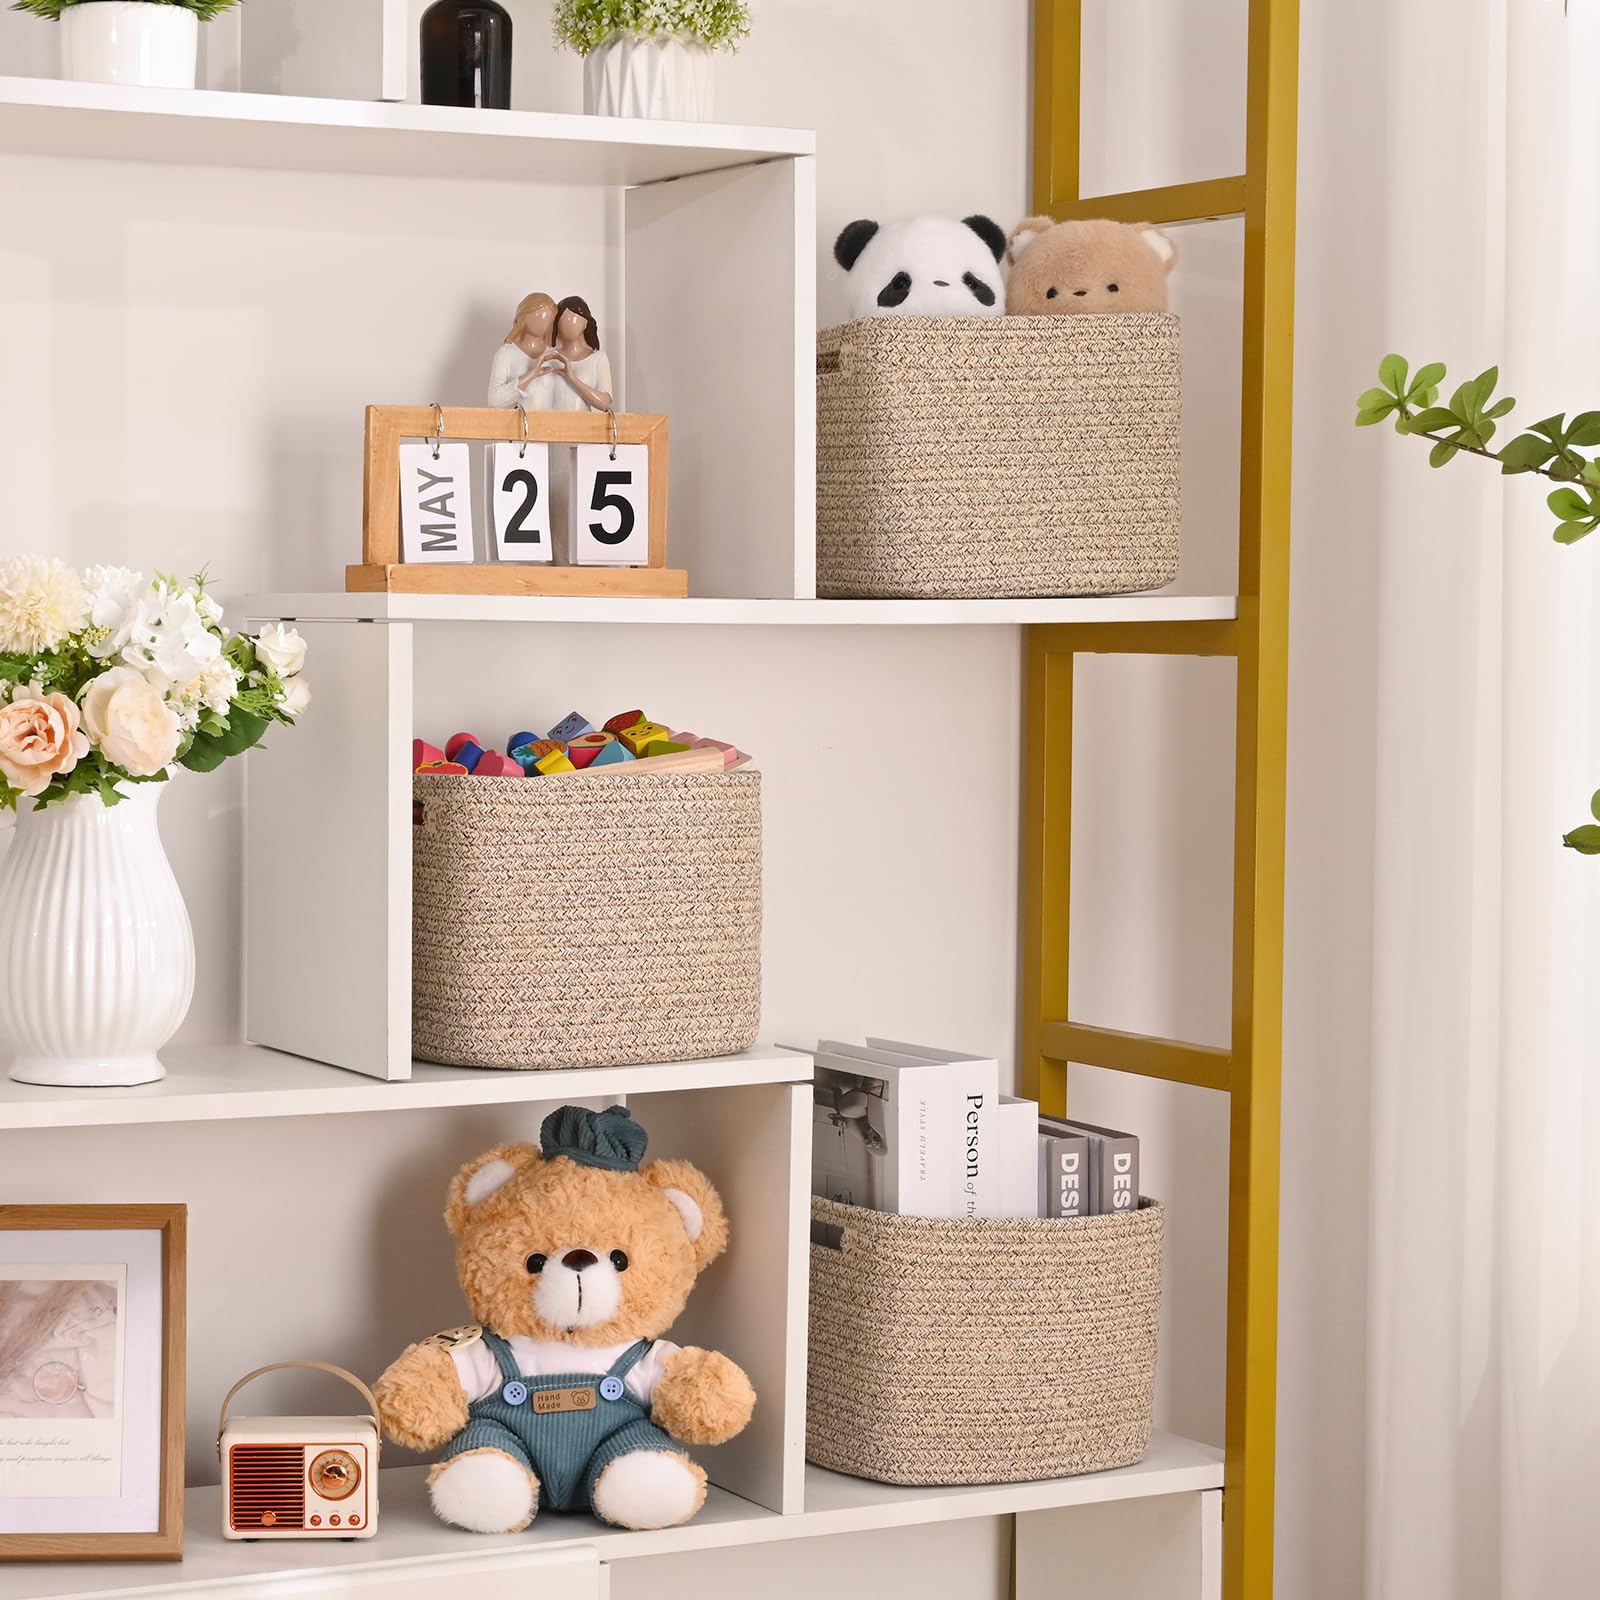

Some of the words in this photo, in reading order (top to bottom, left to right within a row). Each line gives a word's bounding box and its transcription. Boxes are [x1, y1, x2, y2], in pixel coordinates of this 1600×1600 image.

[417, 467, 457, 552] MAY
[502, 468, 541, 544] 2
[588, 471, 635, 545] 5
[919, 1099, 927, 1130] STYLE
[966, 1093, 983, 1178] Person
[963, 1182, 977, 1196] of
[1061, 1152, 1079, 1217] DESI
[537, 1393, 561, 1402] Hand
[537, 1402, 561, 1411] Made
